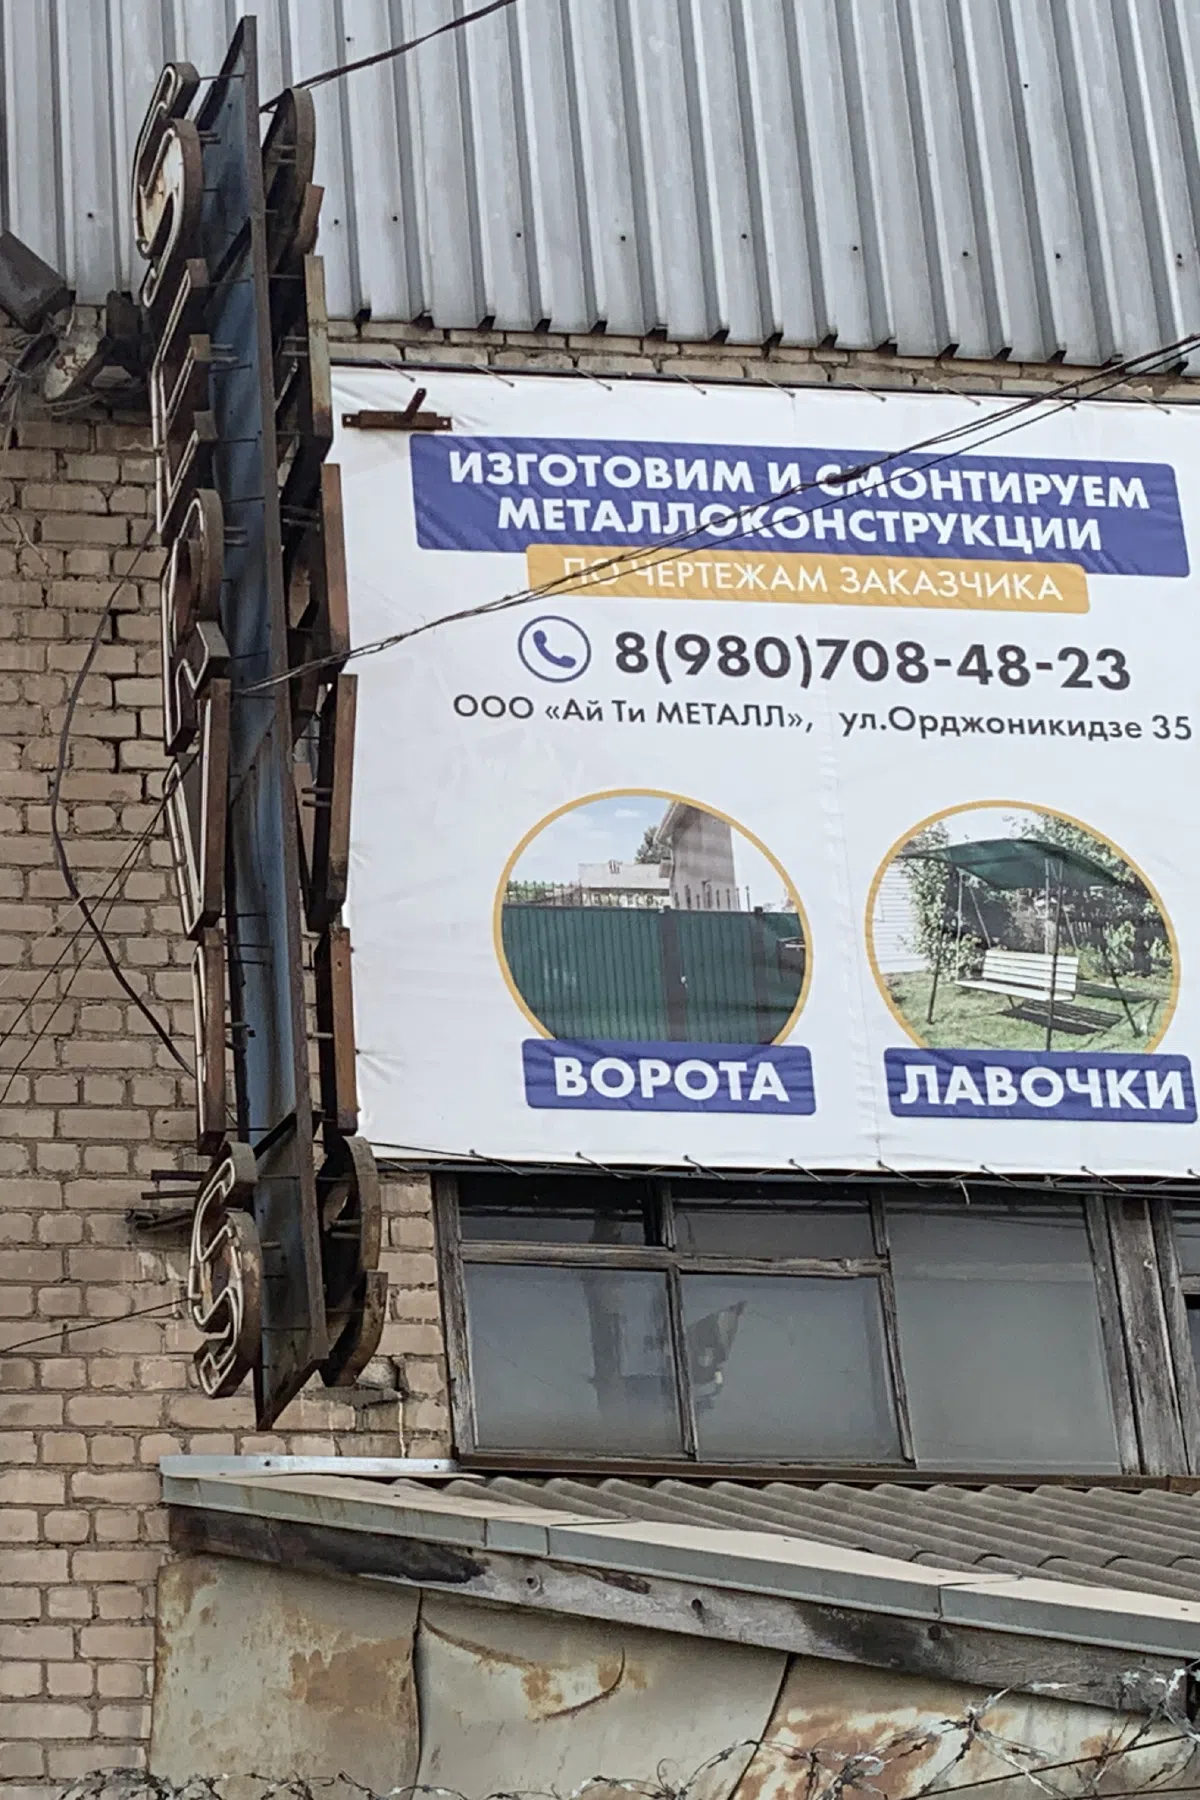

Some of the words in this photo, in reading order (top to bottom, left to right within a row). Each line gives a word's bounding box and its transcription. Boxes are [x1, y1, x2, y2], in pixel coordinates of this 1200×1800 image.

[449, 450, 754, 494] ИЗГОТОВИМ
[767, 462, 803, 495] И
[814, 463, 1151, 510] СМОНТИРУЕМ
[497, 497, 1102, 555] МЕТАЛЛОКОНСТРУКЦИИ
[564, 557, 620, 587] ПО
[633, 560, 828, 593] ЧЕРТЕЖАМ
[839, 566, 1065, 601] ЗАКАЗЧИКА
[614, 629, 1132, 691] 8(980)708-48-23
[452, 693, 534, 720] ООО
[545, 697, 604, 723] «Ай
[611, 700, 647, 724] Ти
[655, 701, 814, 734] МЕТАЛЛ»,
[838, 705, 1143, 742] ул.Орджоникидзе
[1151, 714, 1193, 741] 35
[552, 1055, 791, 1104] ВОРОТА
[900, 1063, 1187, 1111] ЛАВОЧКИ
